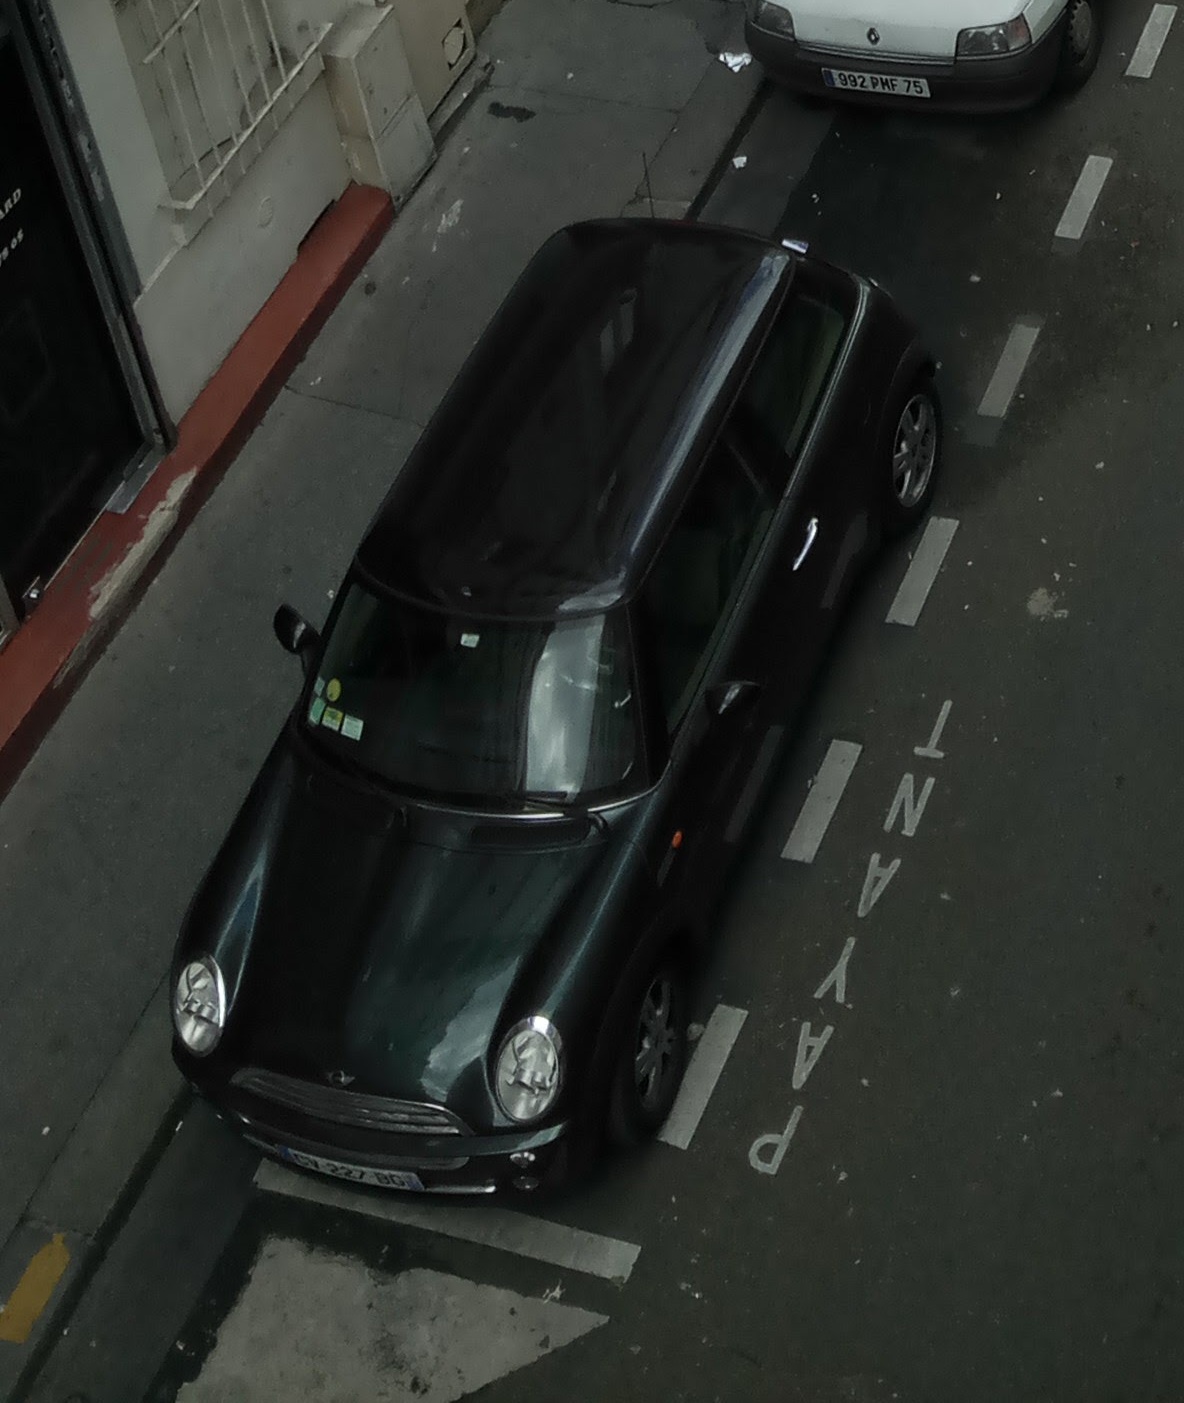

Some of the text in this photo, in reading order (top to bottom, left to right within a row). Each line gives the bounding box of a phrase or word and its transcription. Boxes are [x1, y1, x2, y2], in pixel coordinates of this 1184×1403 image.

[838, 72, 867, 89] 992
[903, 79, 925, 95] 75
[748, 699, 953, 1176] PAYANT
